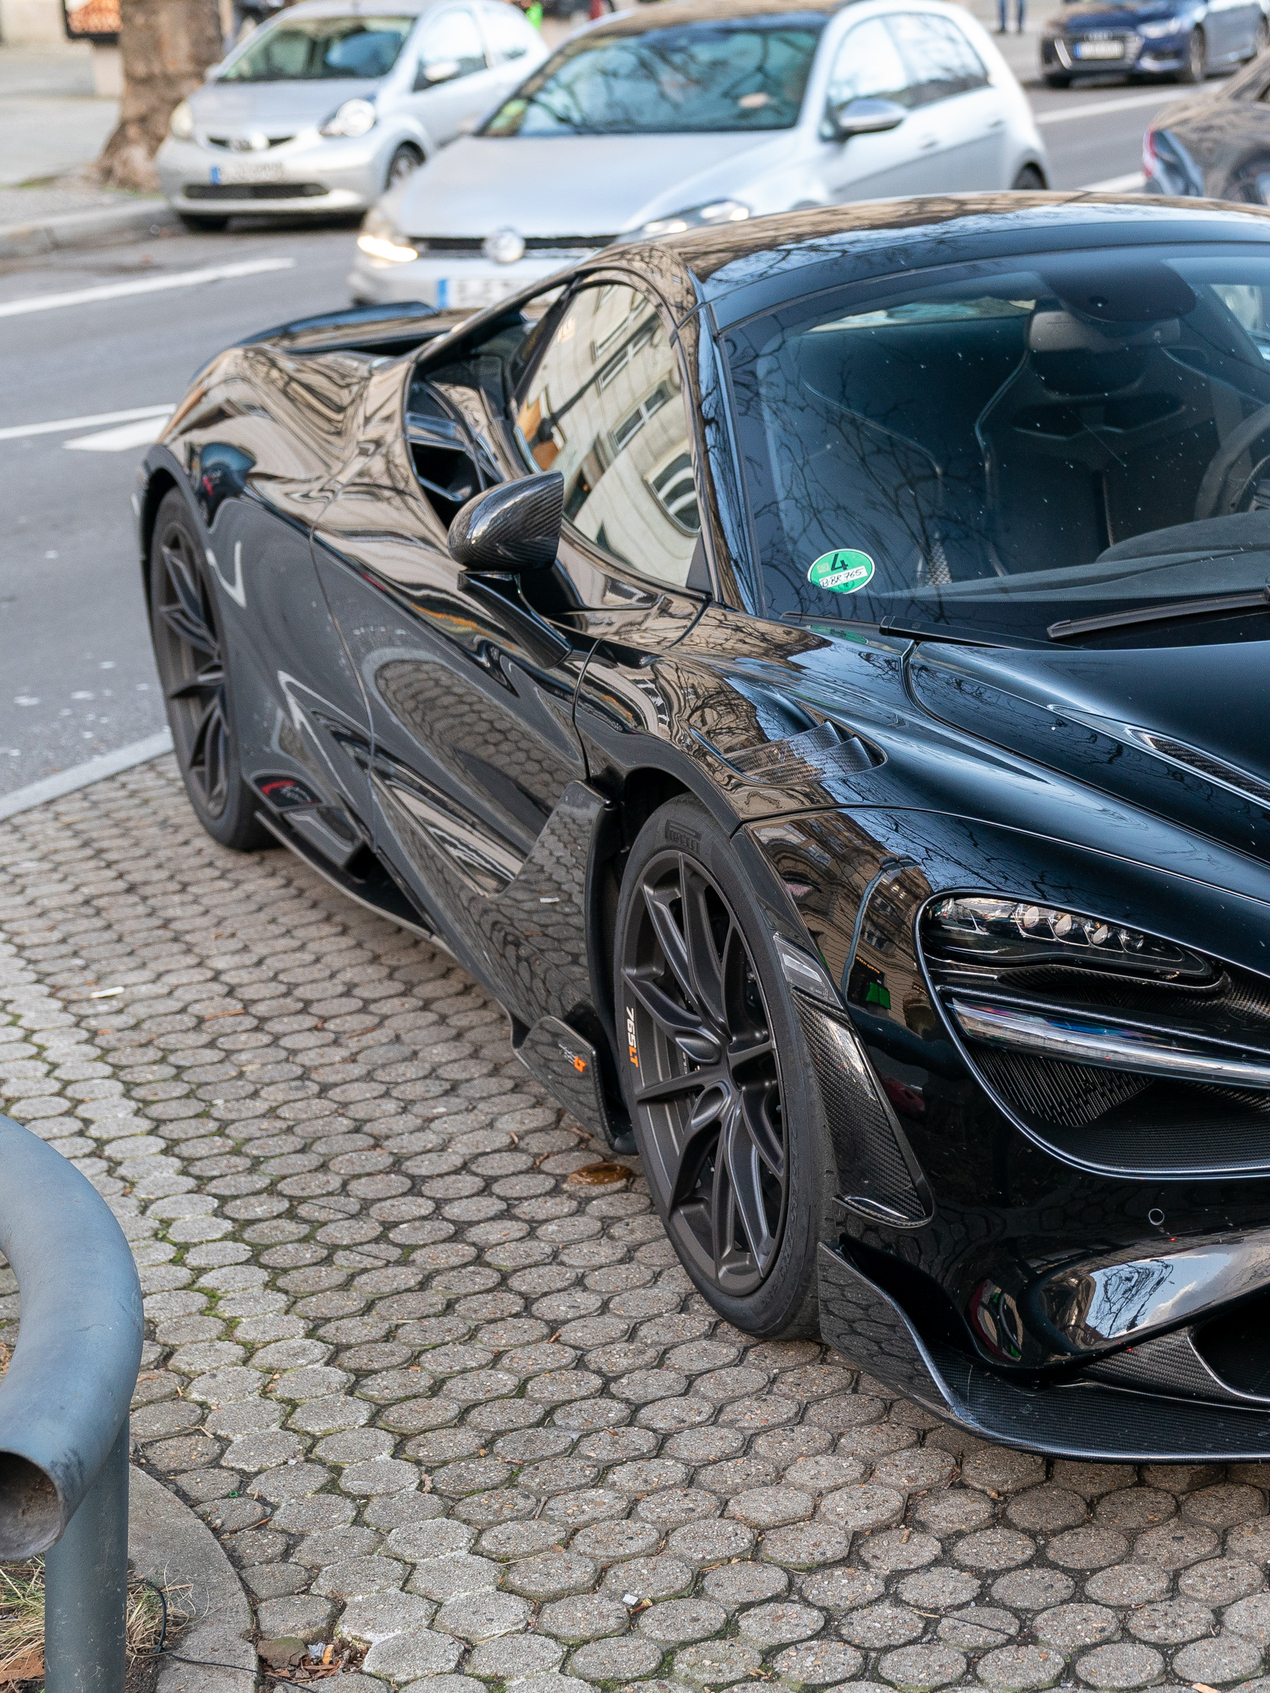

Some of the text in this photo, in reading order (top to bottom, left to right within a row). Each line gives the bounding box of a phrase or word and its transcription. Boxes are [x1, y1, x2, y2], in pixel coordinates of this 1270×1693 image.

[831, 553, 848, 571] 4
[843, 567, 865, 580] 765
[665, 819, 702, 853] PIRELLI
[626, 1006, 639, 1068] 765LT
